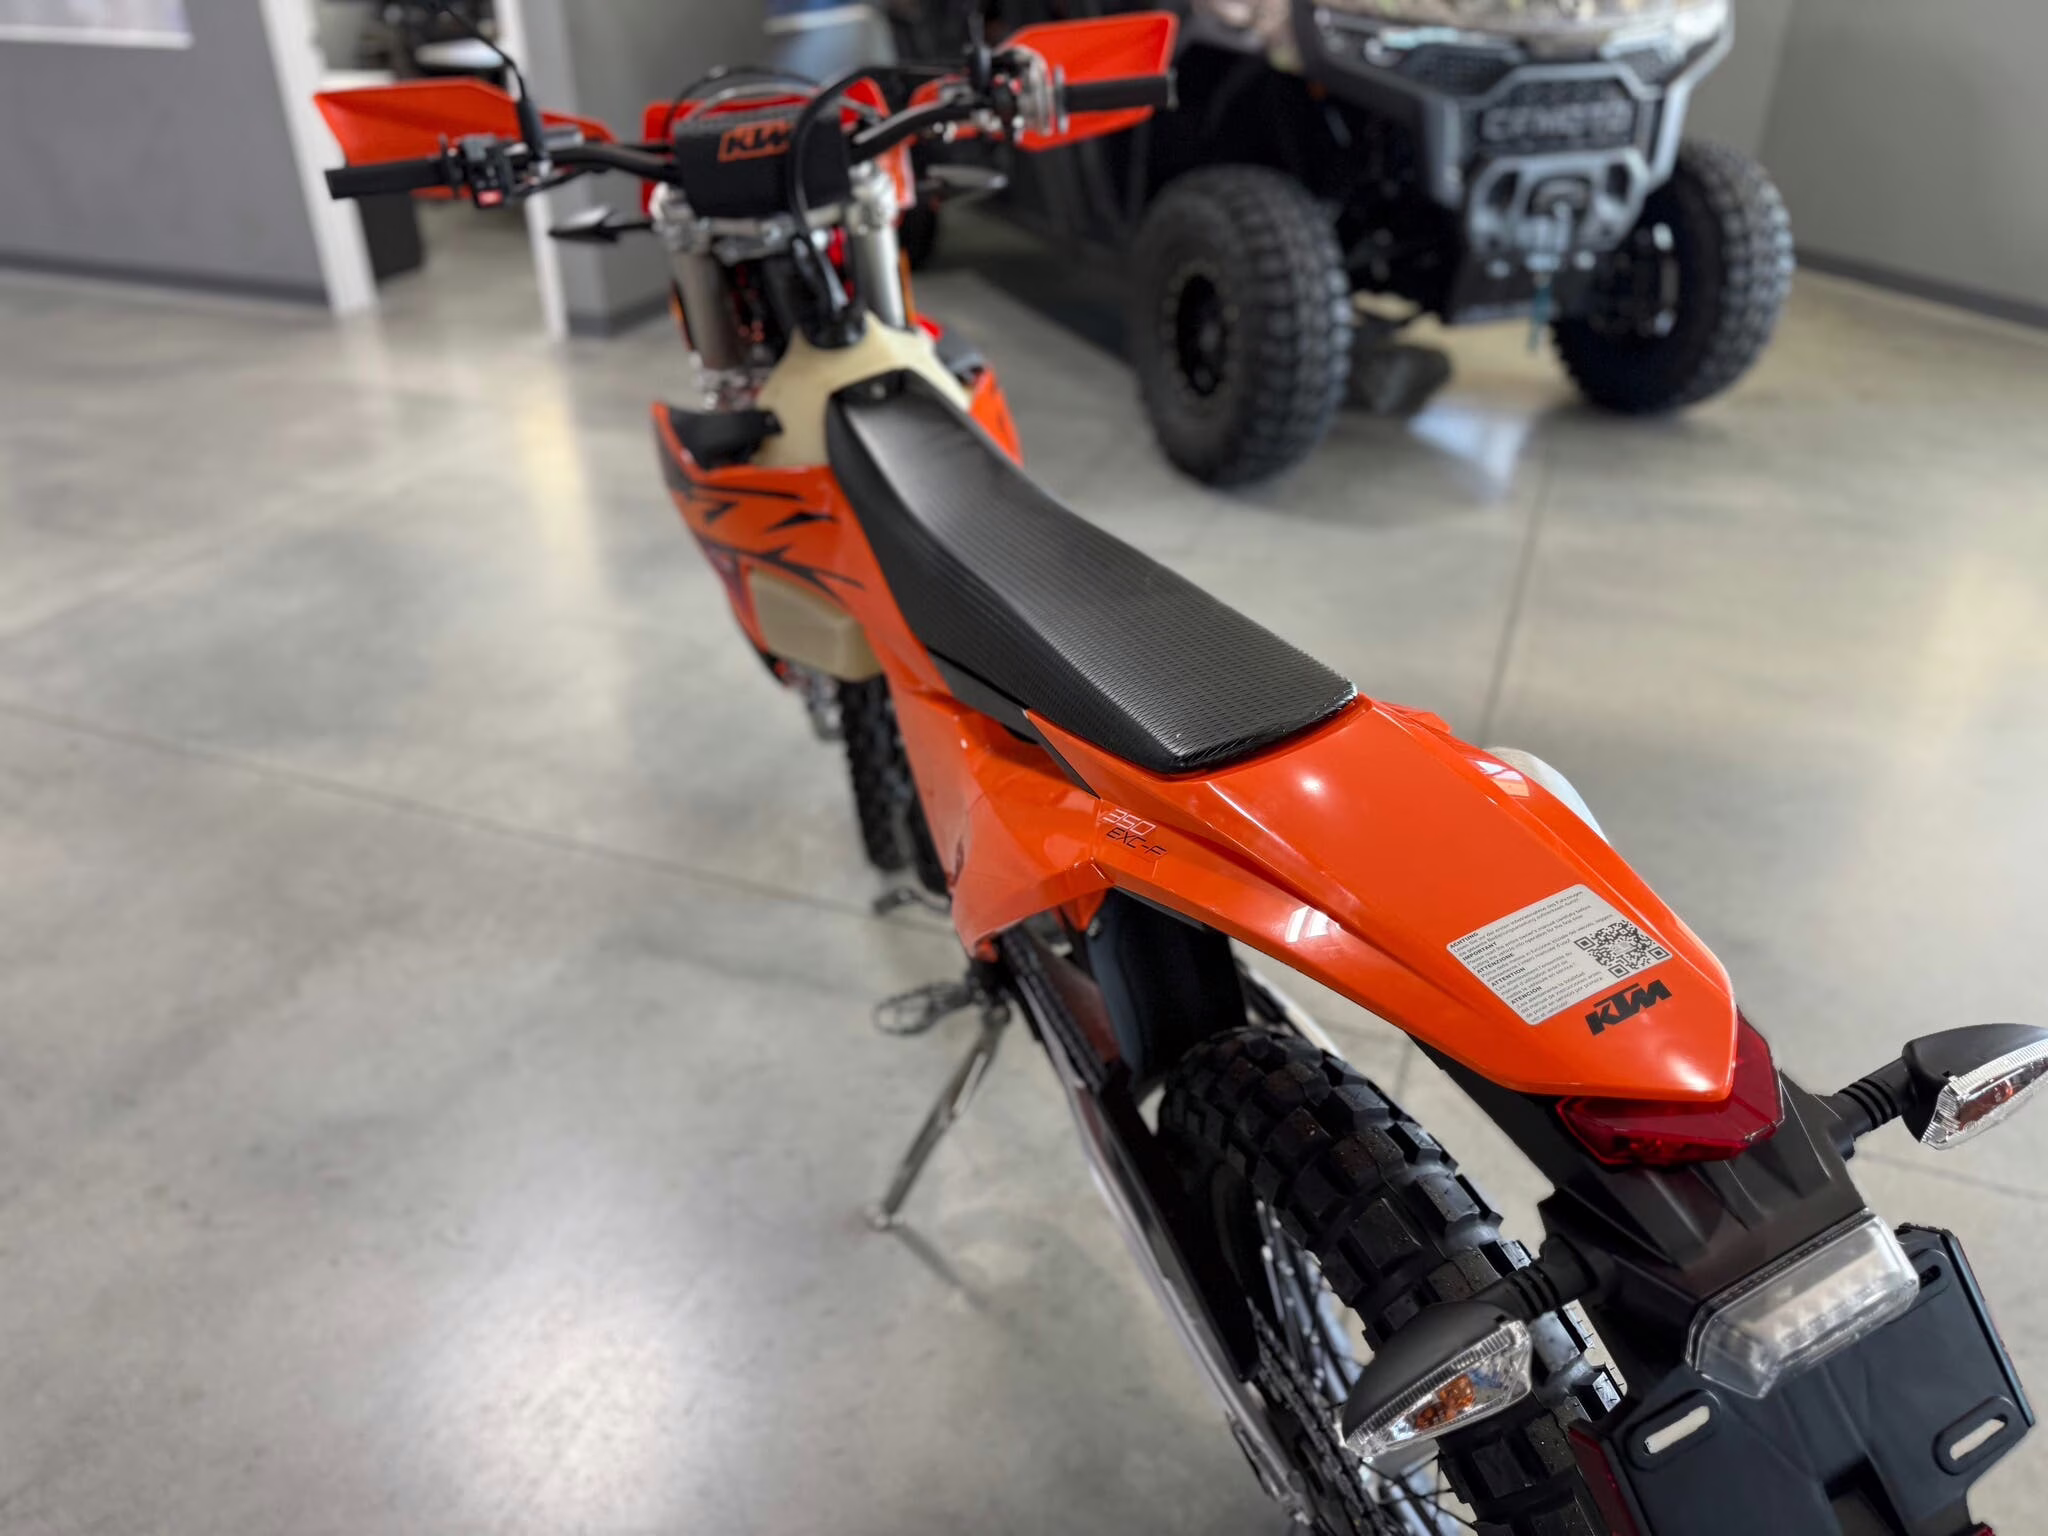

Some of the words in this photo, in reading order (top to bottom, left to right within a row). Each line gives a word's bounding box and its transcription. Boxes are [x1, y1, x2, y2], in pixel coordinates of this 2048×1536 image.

[1102, 808, 1157, 836] 350
[1106, 827, 1168, 856] EXC-F
[1449, 931, 1478, 948] ACHTUNG
[1461, 941, 1497, 960] IMPORTANT
[1476, 952, 1514, 973] ATTENZIONE
[1490, 966, 1526, 986] ATTENTION
[1585, 979, 1672, 1035] KTM
